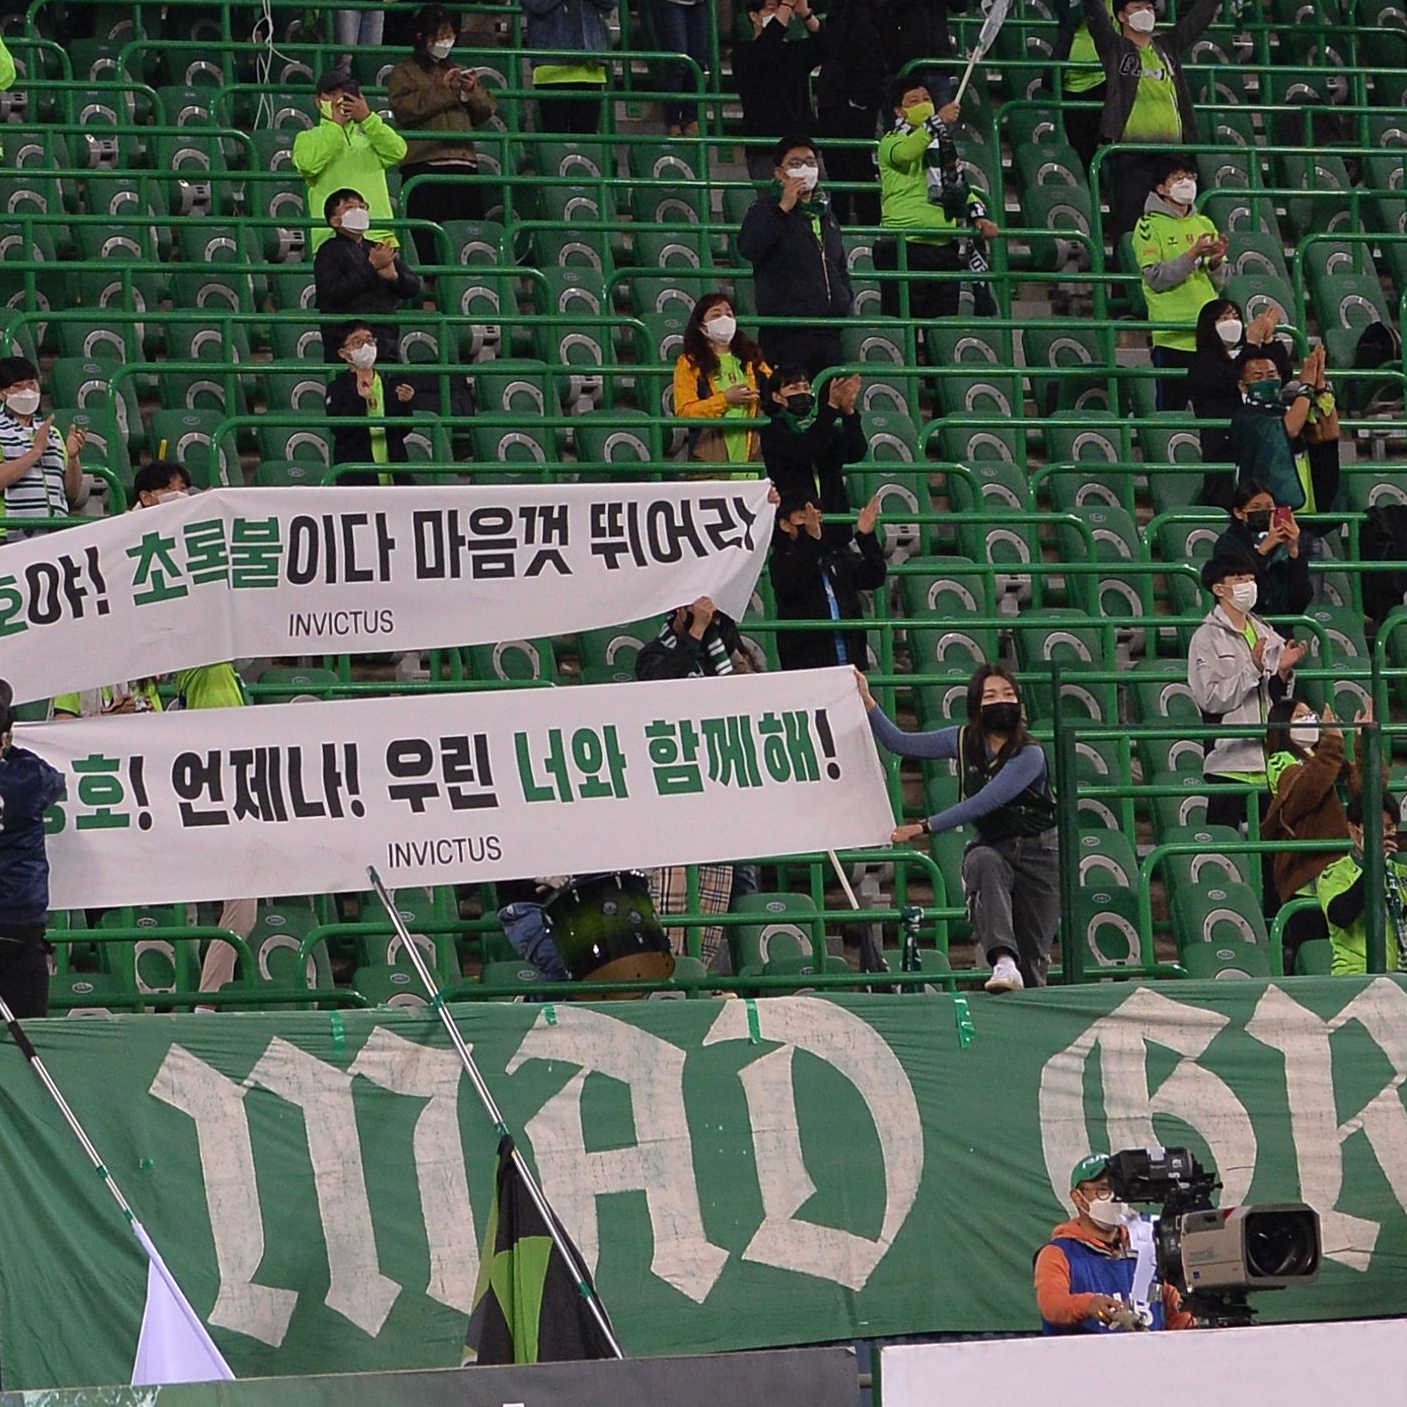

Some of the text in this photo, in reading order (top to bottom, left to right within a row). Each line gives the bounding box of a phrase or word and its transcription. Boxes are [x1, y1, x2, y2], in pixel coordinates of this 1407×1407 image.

[126, 507, 396, 607] 초록불이다
[413, 503, 572, 581] 마음껏
[591, 495, 756, 570] 뛰어라
[288, 609, 395, 637] INVICTUS
[43, 709, 841, 834] 호! 언제나! 우린 너와 함께해!
[388, 836, 502, 870] INVICTUS
[148, 996, 924, 1348] MAD
